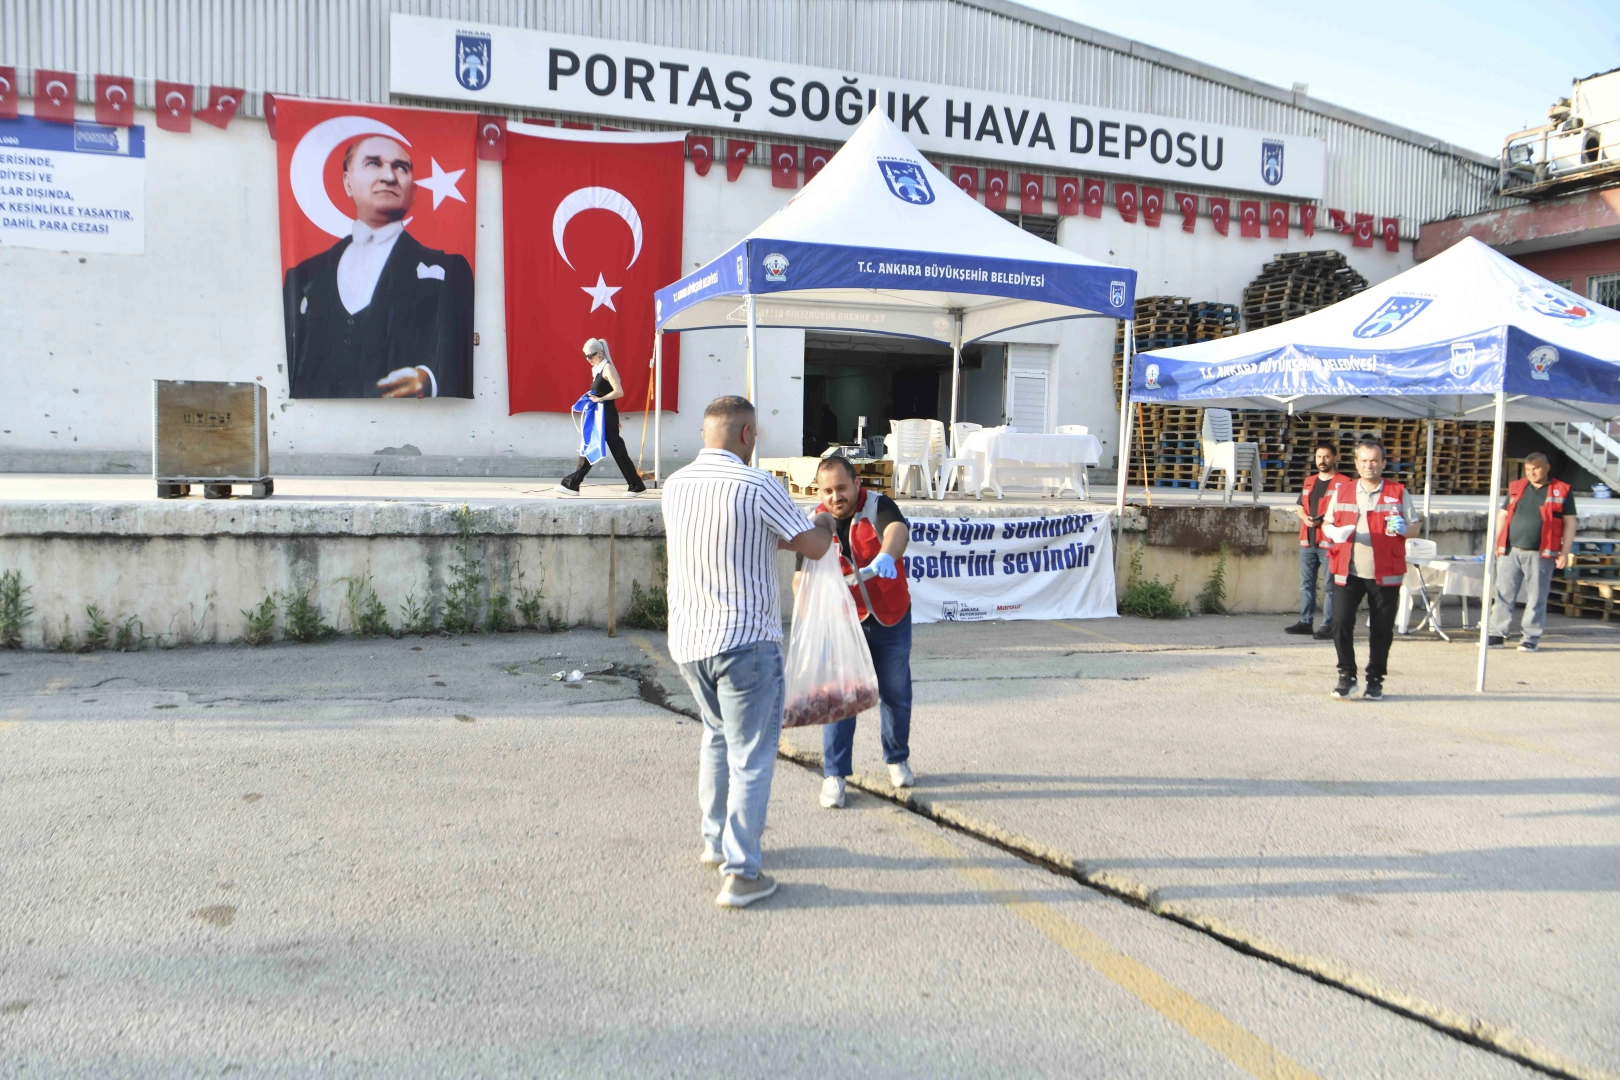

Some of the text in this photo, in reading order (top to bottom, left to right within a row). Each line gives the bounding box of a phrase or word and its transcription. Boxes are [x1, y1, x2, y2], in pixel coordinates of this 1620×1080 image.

[549, 47, 1224, 171] PORTAŞ SOĞUK HAVA DEPOSU
[876, 156, 920, 165] ANKARA
[0, 168, 53, 183] DİYESİ VE
[9, 202, 74, 216] KESİNLİKLE
[2, 217, 109, 235] DAHİL PARA CEZASI
[858, 261, 1045, 288] T.C. ANKARA BÜYÜKŞEHİR BELEDİYESİ
[1216, 362, 1257, 379] ANKARA
[1002, 542, 1095, 575] sevindir
[996, 603, 1023, 611] Mansur
